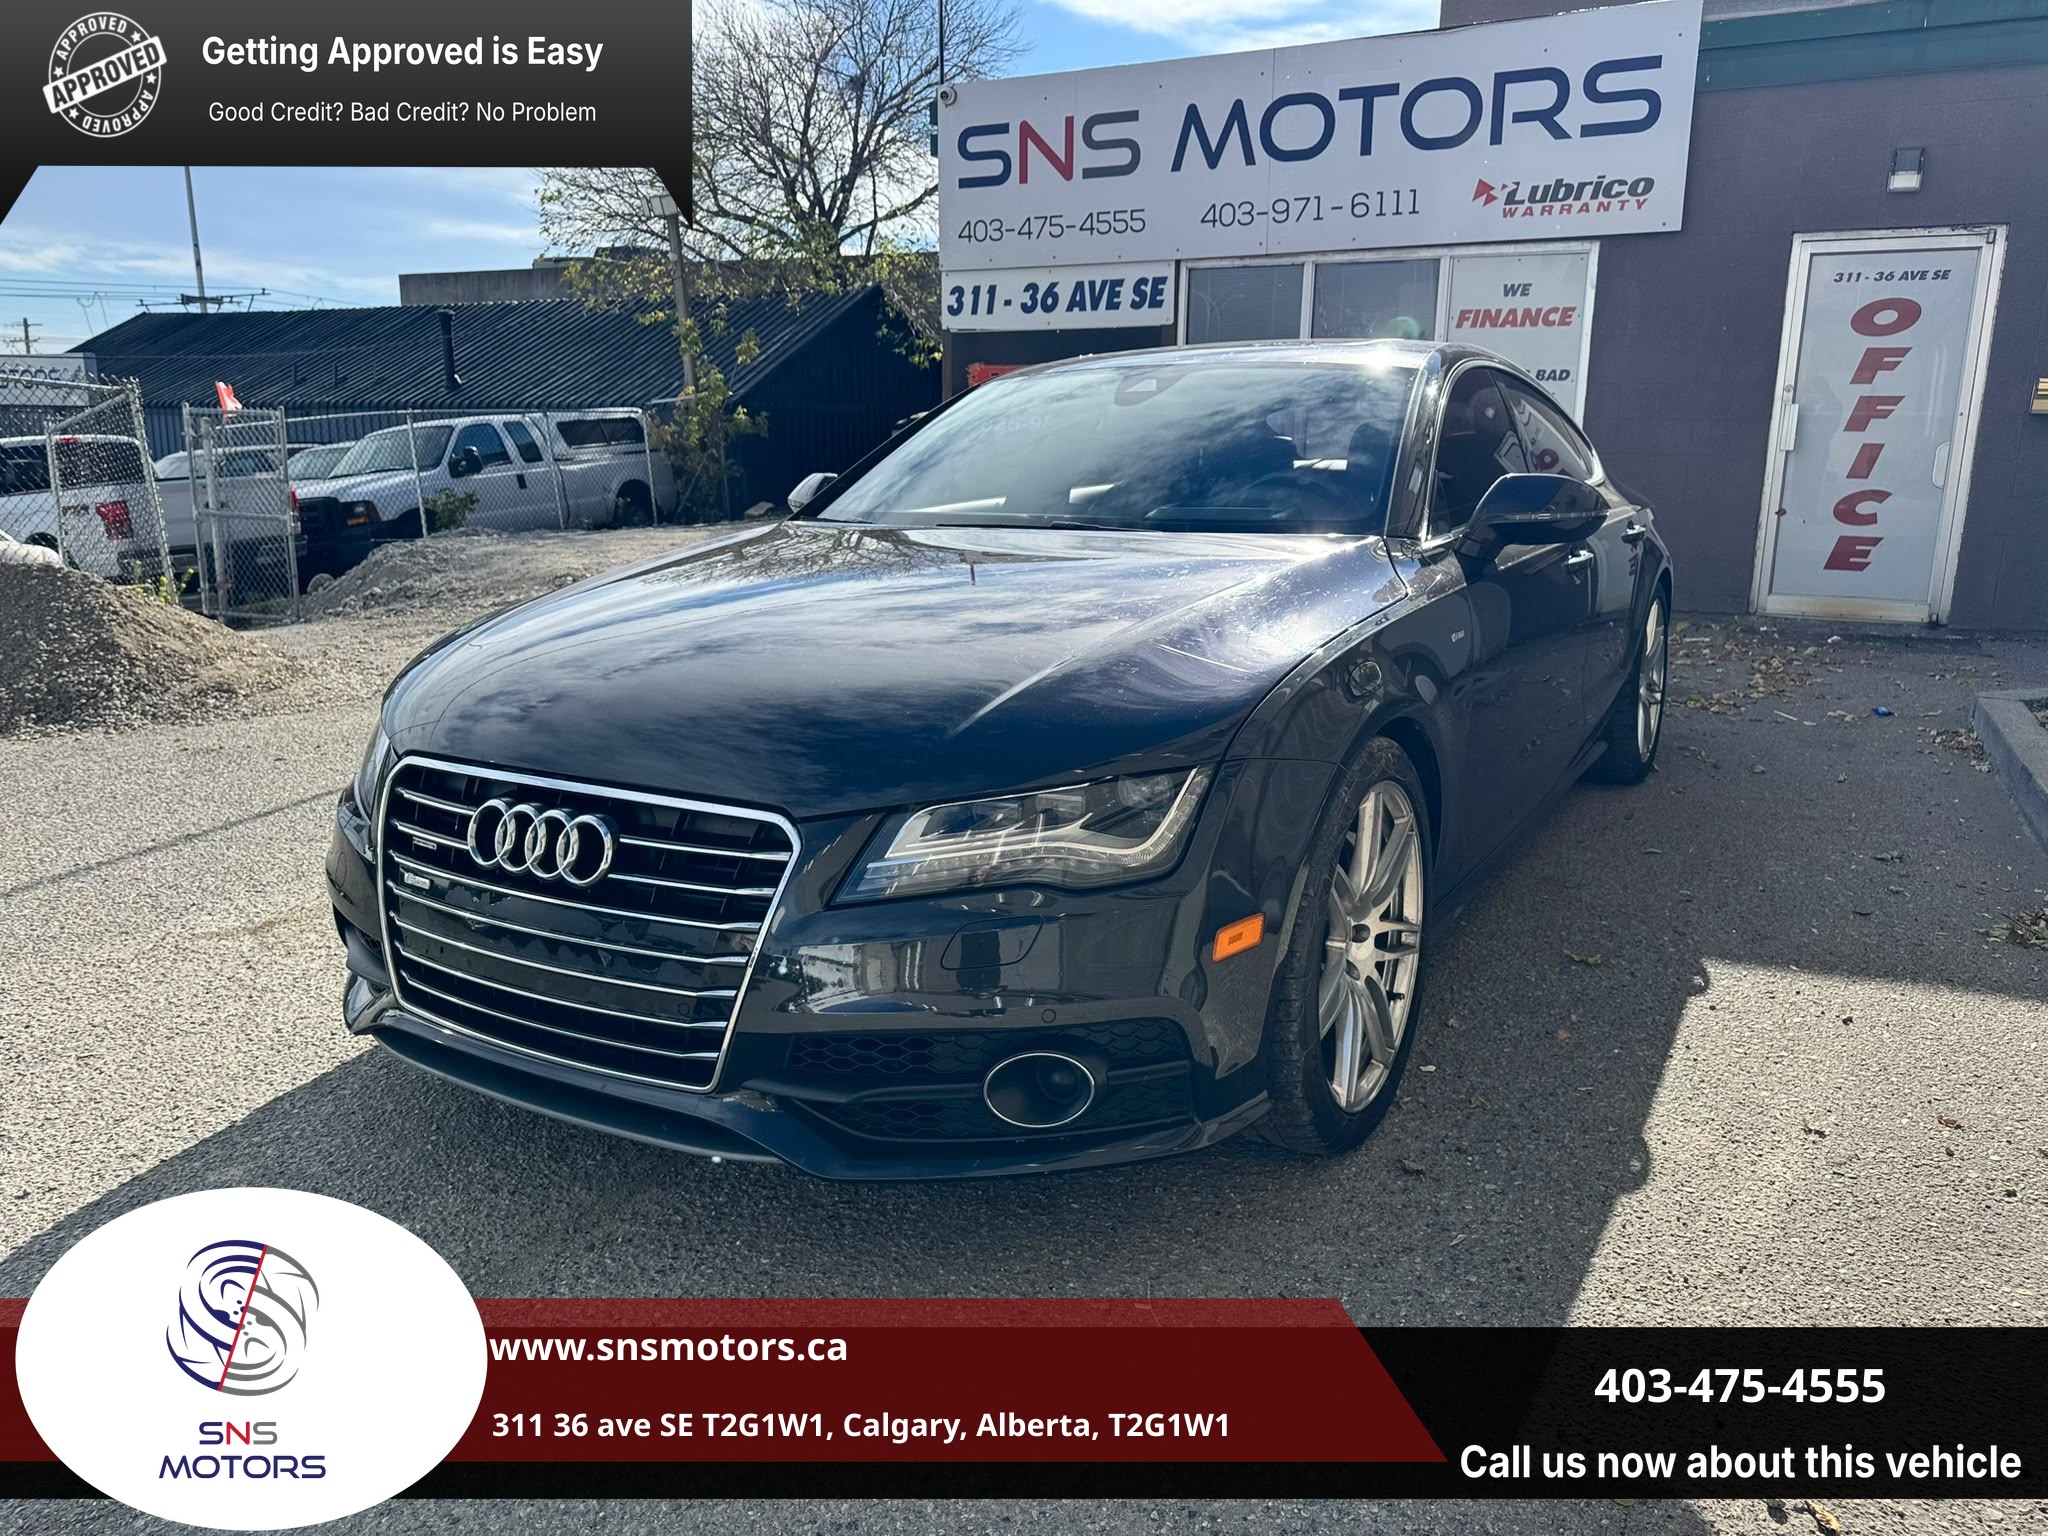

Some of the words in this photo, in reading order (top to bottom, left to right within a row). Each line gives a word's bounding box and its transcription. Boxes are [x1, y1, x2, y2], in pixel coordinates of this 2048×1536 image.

[957, 109, 1142, 189] SNS
[1171, 54, 1663, 174] MOTORS
[1503, 175, 1655, 206] Lubrico
[1199, 188, 1421, 228] 403-971-6111
[1502, 198, 1649, 219] WARRANTY
[957, 208, 1146, 243] 403-475-4555
[1503, 283, 1533, 297] WE
[1897, 270, 1930, 281] AVE
[1931, 269, 1952, 280] SE
[1065, 278, 1125, 313] AVE
[1129, 275, 1168, 310] SE
[1455, 306, 1577, 329] FINANCE
[1535, 368, 1571, 382] BAD
[1823, 297, 1922, 572] OFFICE
